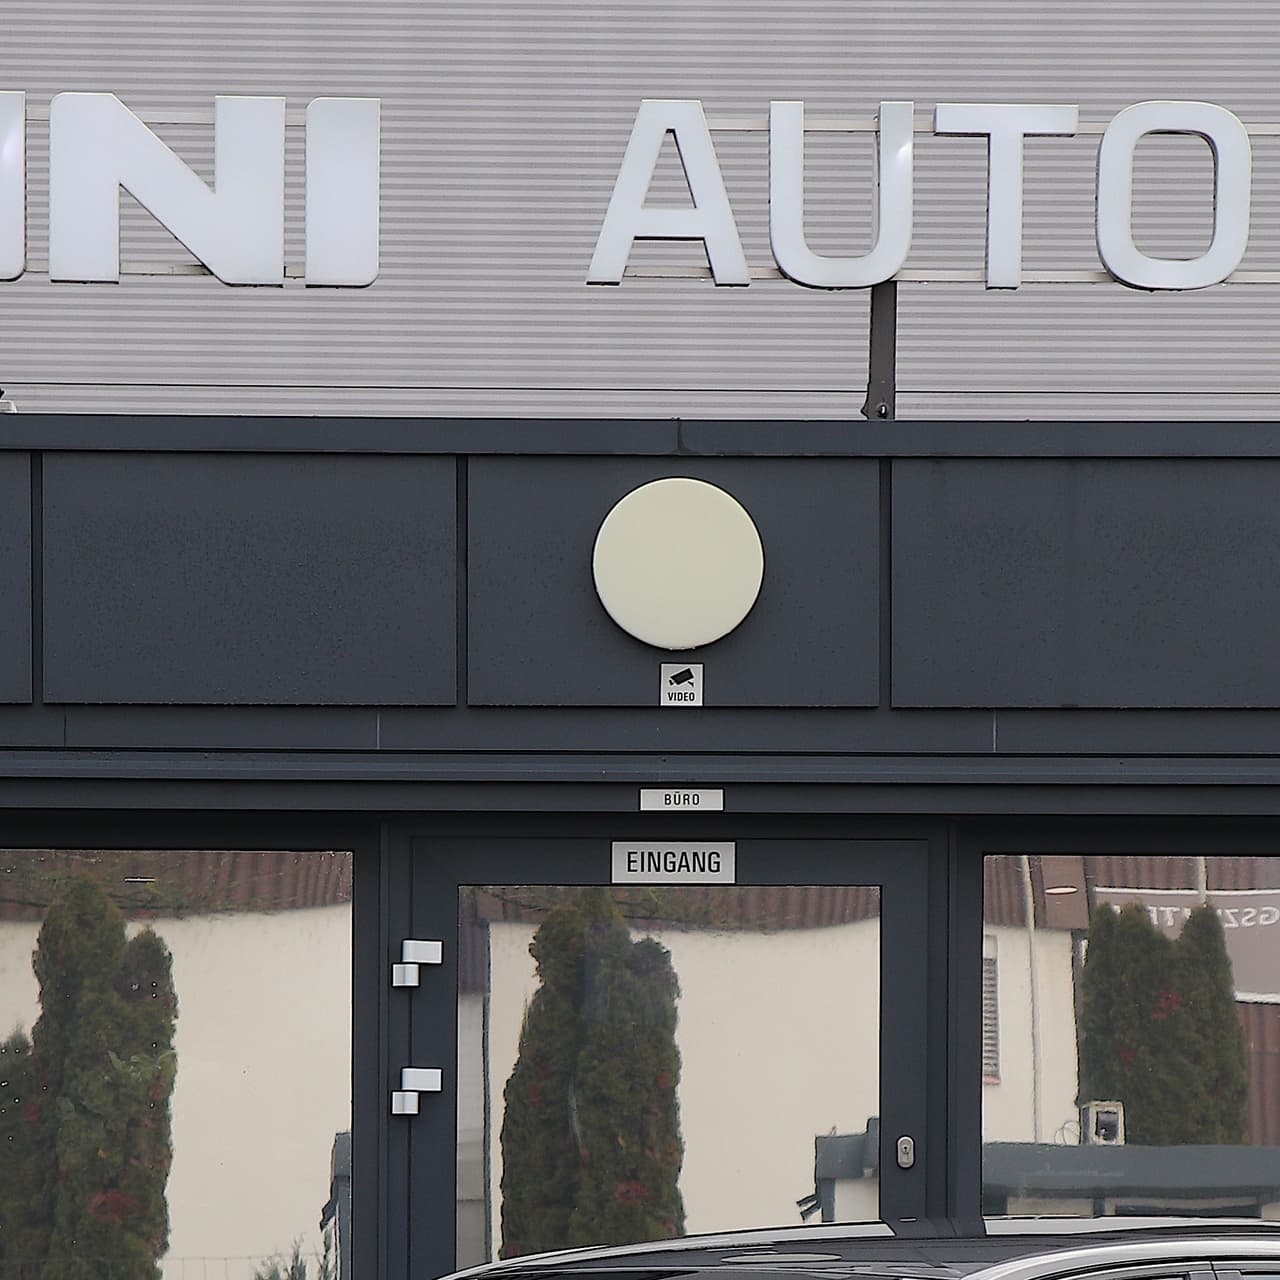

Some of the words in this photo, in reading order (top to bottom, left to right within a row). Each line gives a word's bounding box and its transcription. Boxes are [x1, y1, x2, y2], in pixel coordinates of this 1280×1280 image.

[586, 99, 1254, 291] AUTO
[667, 692, 696, 702] VIDEO
[664, 791, 700, 805] BÜRO
[626, 851, 721, 873] EINGANG
